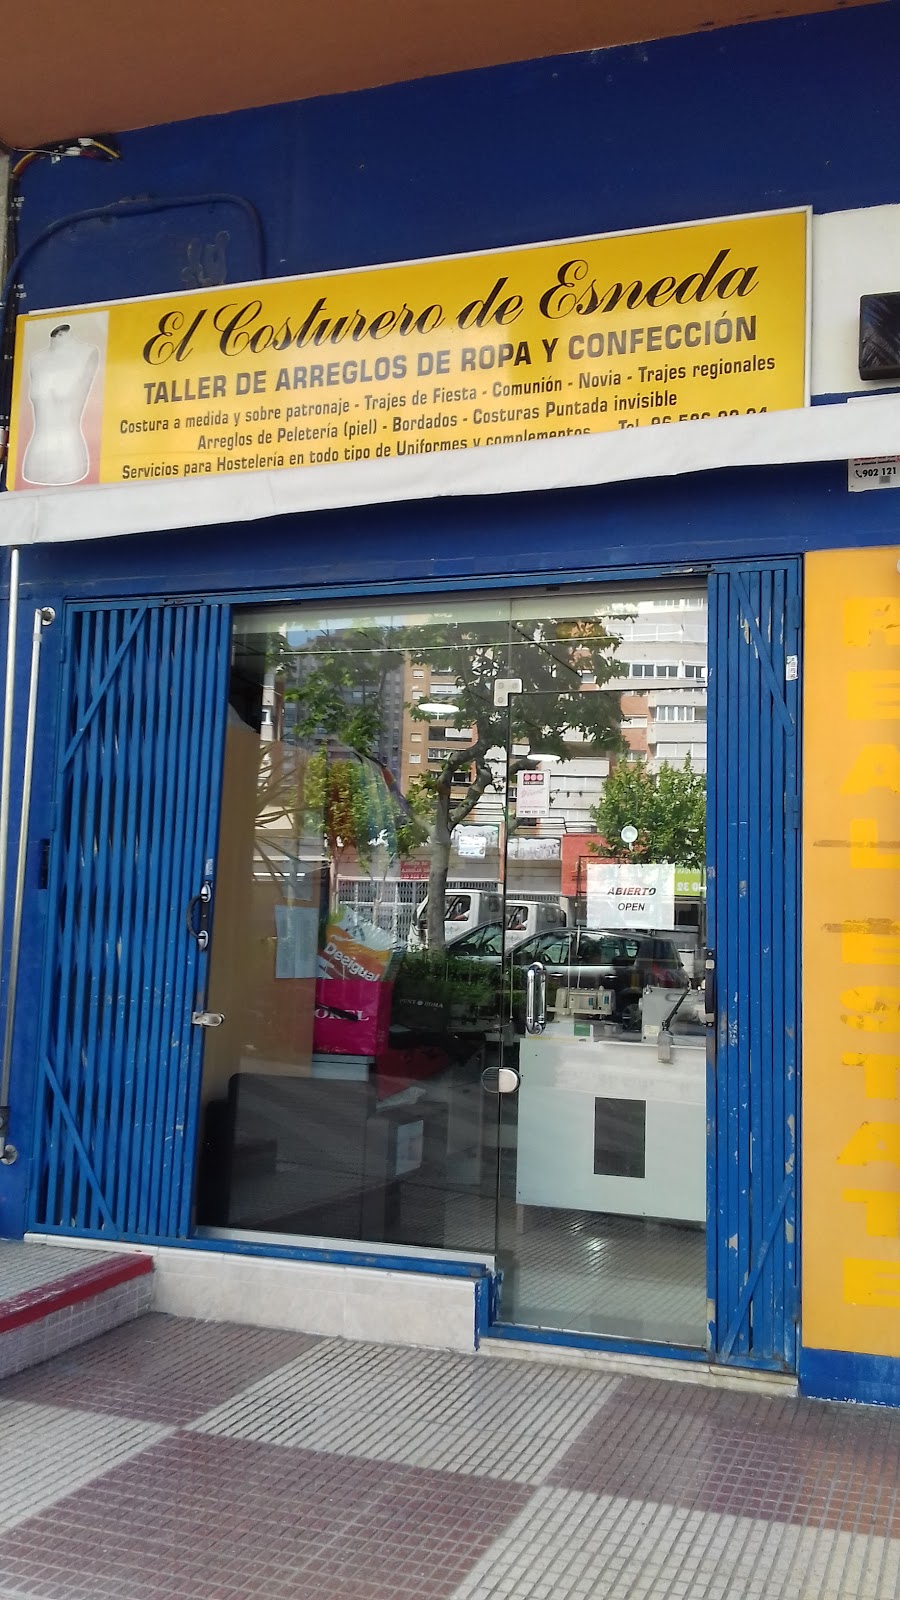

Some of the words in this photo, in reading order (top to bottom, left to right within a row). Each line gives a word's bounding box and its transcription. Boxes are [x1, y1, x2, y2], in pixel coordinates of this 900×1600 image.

[143, 309, 208, 365] El
[213, 297, 446, 356] Costurero
[456, 276, 524, 329] de
[539, 248, 760, 319] Esneda
[143, 374, 227, 404] TALLER
[236, 370, 267, 396] DE
[275, 354, 407, 391] ARREGLOS
[417, 349, 451, 376] DE
[461, 341, 532, 372] ROPA
[542, 338, 559, 362] Y
[568, 310, 757, 360] CONFECCIÓN
[120, 419, 169, 434] Costura
[174, 418, 180, 429] a
[186, 410, 228, 428] medida
[233, 412, 241, 427] y
[245, 406, 281, 422] sobre
[286, 398, 350, 421] patronaje
[364, 393, 406, 411] Trajes
[412, 390, 427, 406] de
[433, 387, 477, 404] Fiesta
[492, 376, 562, 398] Comunión
[578, 370, 621, 389] Novia
[638, 364, 686, 383] Trajes
[692, 355, 776, 380] regionales
[197, 432, 253, 451] Arreglos
[258, 430, 272, 445] de
[277, 422, 338, 443] Peletería
[343, 418, 377, 440] (piel)
[392, 412, 457, 433] Bordados
[473, 407, 540, 425] Costuras
[545, 397, 608, 417] Puntada
[614, 390, 678, 411] invisible
[122, 462, 179, 479] Servicios
[183, 462, 212, 477] para
[217, 451, 284, 472] Hostelería
[289, 453, 304, 465] en
[310, 447, 339, 463] todo
[344, 445, 370, 461] tipo
[375, 443, 391, 457] de
[396, 438, 468, 456] Uniformes
[473, 438, 481, 447] y
[862, 469, 879, 477] 902
[882, 467, 897, 476] 121
[607, 887, 657, 896] ABIERTO
[617, 902, 646, 911] OPEN
[324, 942, 380, 981] Desigual
